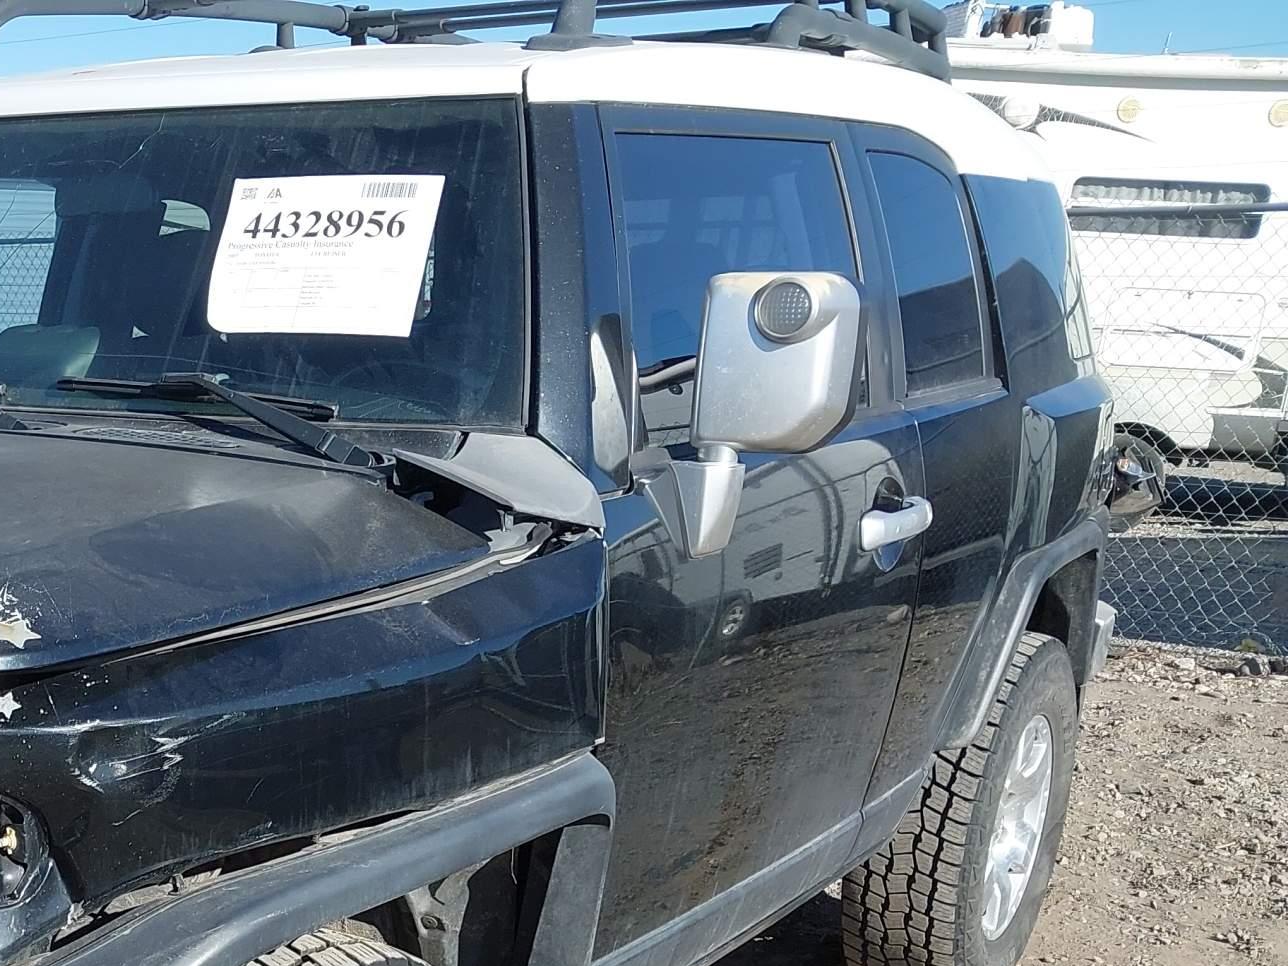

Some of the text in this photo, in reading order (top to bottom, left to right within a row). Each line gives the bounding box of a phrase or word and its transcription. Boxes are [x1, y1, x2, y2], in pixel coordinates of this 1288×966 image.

[243, 209, 409, 239] 44328956
[228, 239, 354, 251] Progressive Casualty Insurance
